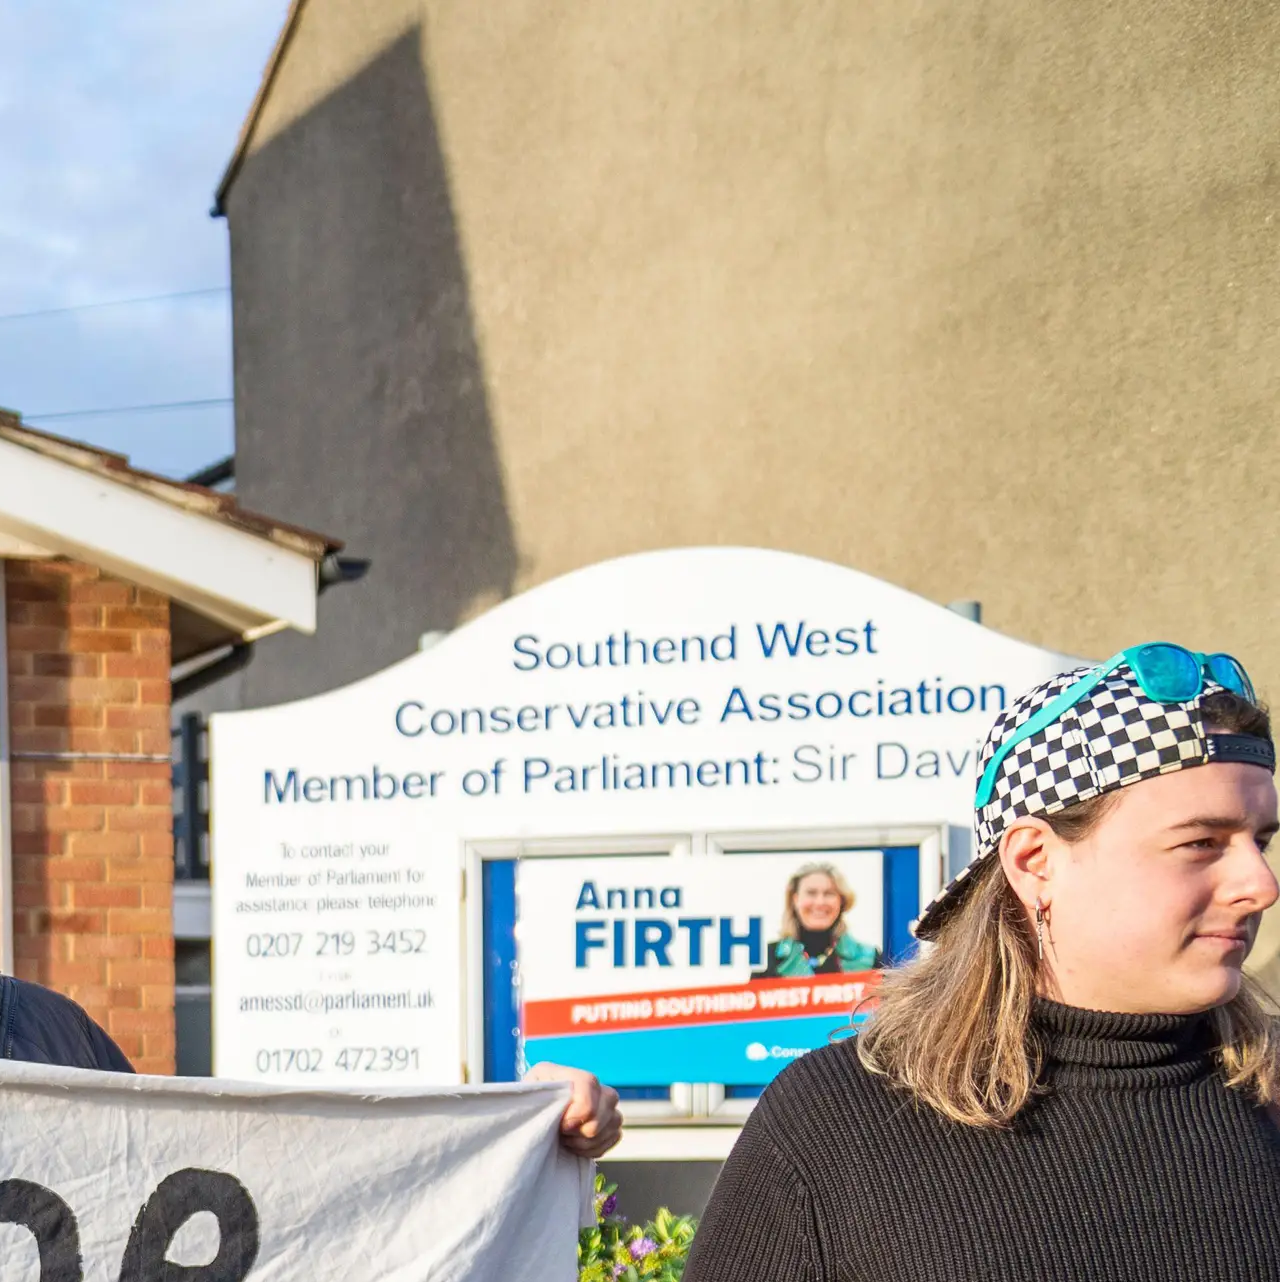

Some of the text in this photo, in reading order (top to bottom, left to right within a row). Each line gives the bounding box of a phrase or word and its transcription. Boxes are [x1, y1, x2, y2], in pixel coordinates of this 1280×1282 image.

[513, 619, 878, 671] Southend West
[395, 677, 1007, 738] Conservative Association
[263, 739, 981, 805] Member of Parliament: Sir Davi
[300, 842, 354, 859] contact
[245, 872, 301, 888] Member
[326, 869, 401, 886] Parliament
[316, 896, 361, 914] please
[575, 881, 682, 911] Anna
[246, 928, 427, 958] 0207 219 3452
[575, 916, 762, 968] FIRTH
[571, 982, 865, 1024] PUTTING SOUTHEND WEST FIRST
[256, 1046, 420, 1074] 01702 472391
